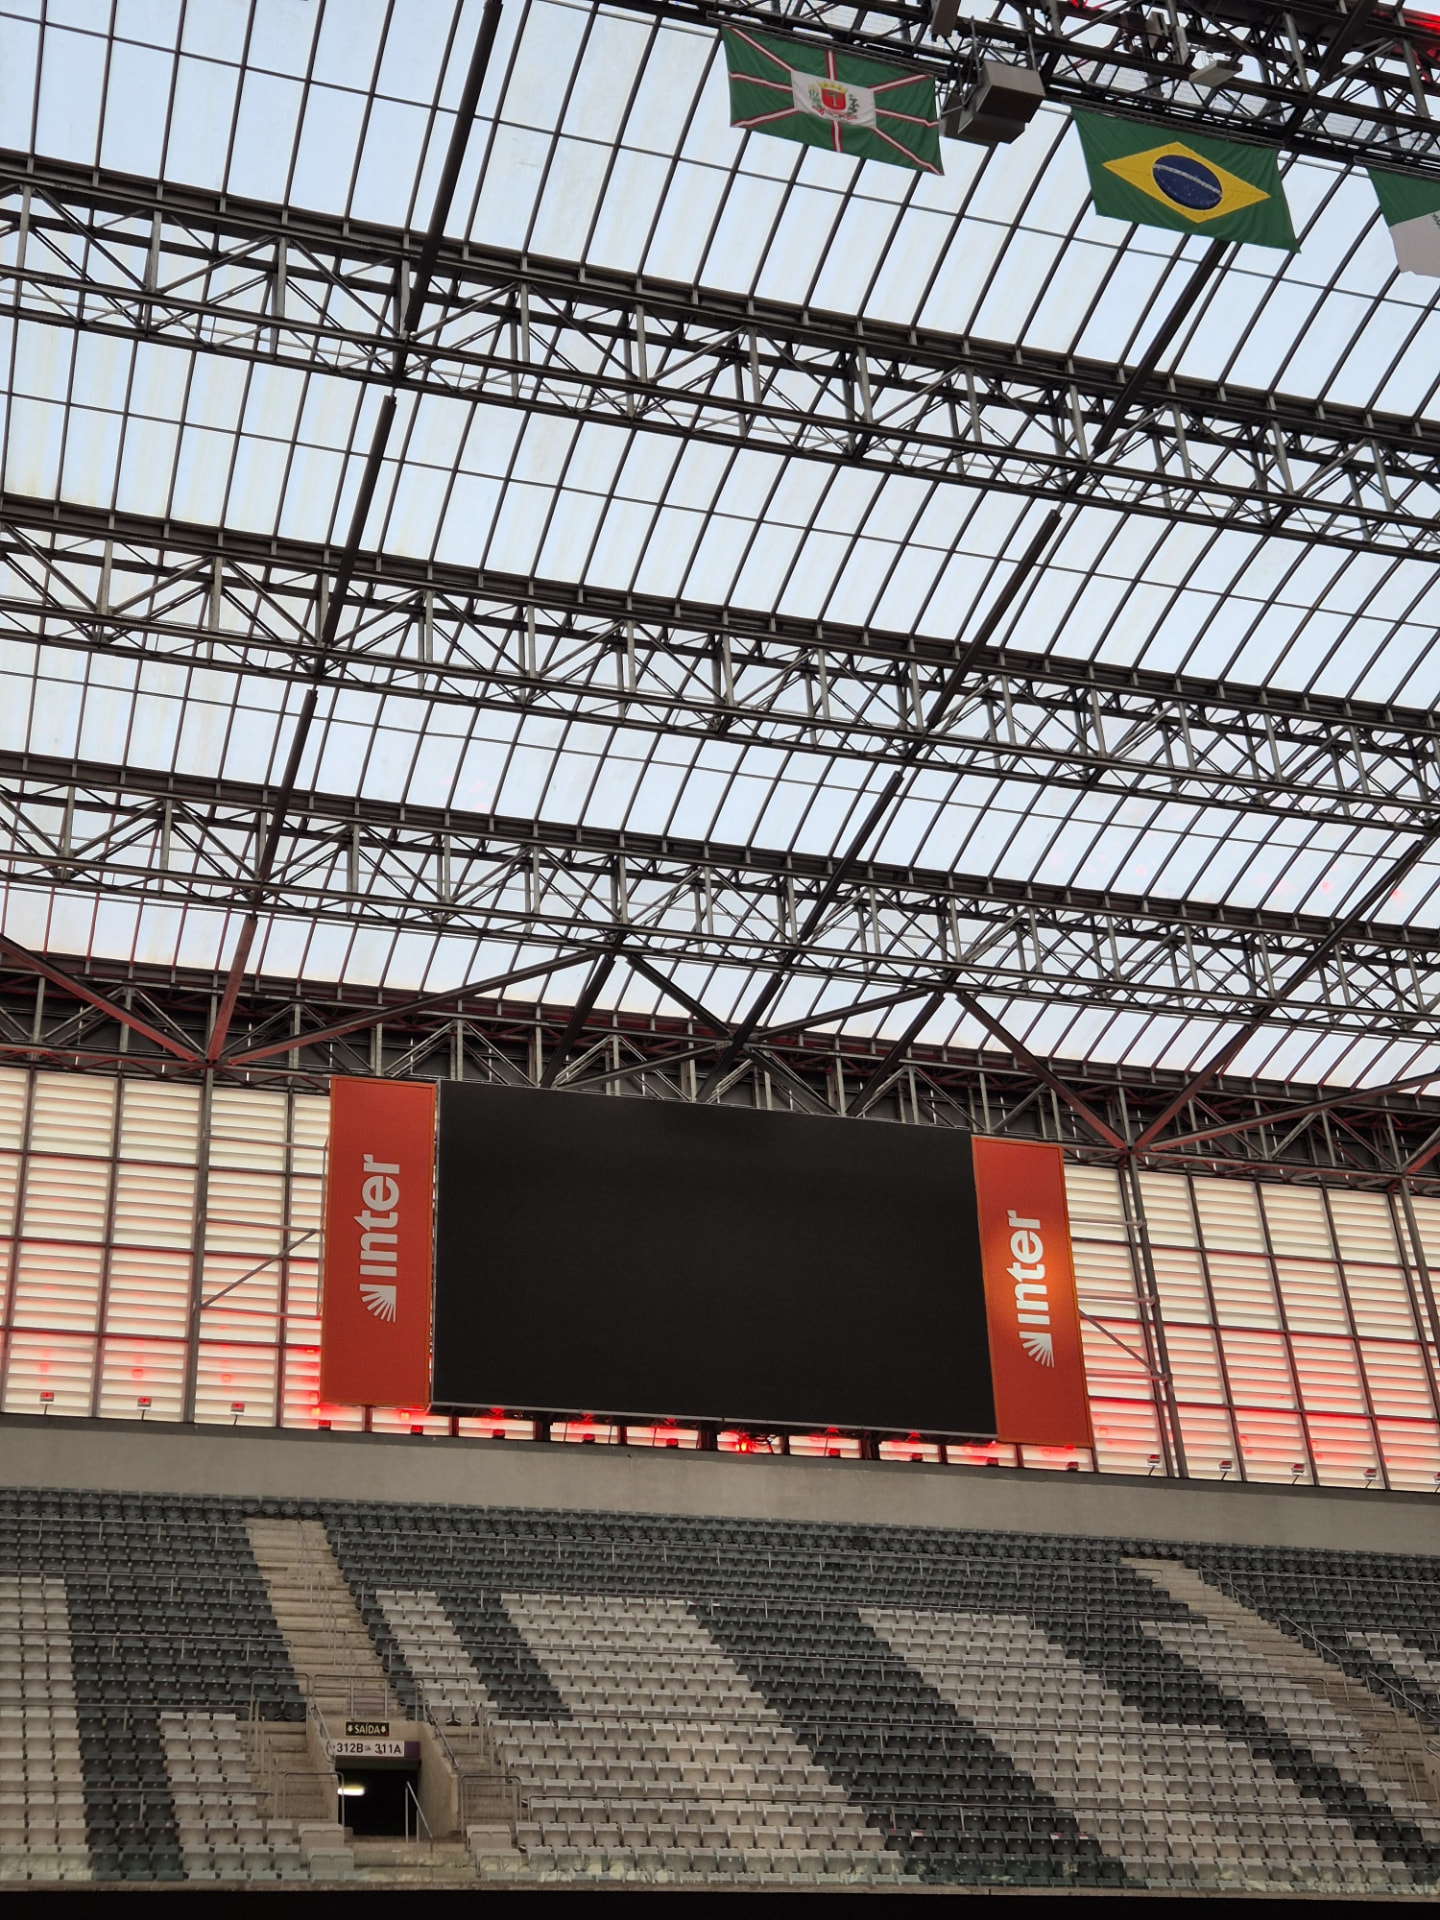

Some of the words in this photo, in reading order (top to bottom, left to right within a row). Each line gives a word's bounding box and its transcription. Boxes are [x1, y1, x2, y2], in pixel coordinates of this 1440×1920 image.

[353, 1153, 400, 1278] inter
[1006, 1209, 1050, 1326] inter
[337, 1743, 364, 1753] 312B
[375, 1743, 402, 1754] 311A
[354, 1723, 381, 1735] SAÍDA
